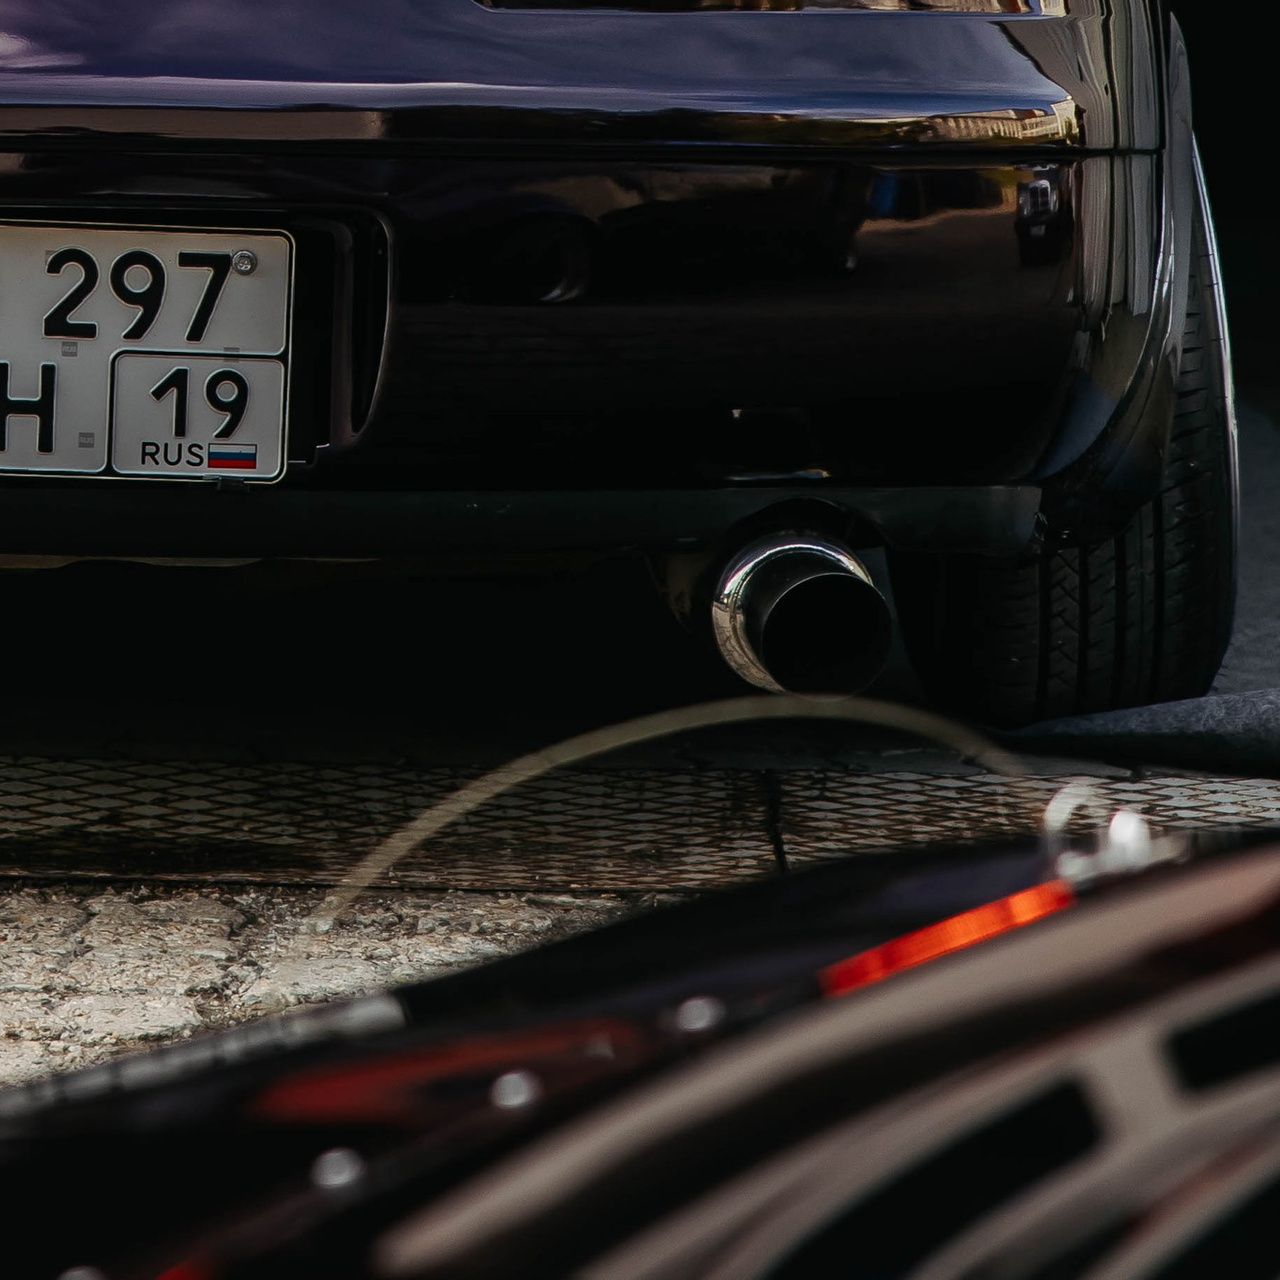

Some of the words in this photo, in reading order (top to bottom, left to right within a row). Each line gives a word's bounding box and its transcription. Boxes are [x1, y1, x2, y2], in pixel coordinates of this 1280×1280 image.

[43, 248, 231, 342] 297
[150, 367, 249, 439] 19
[140, 441, 204, 466] RUS
